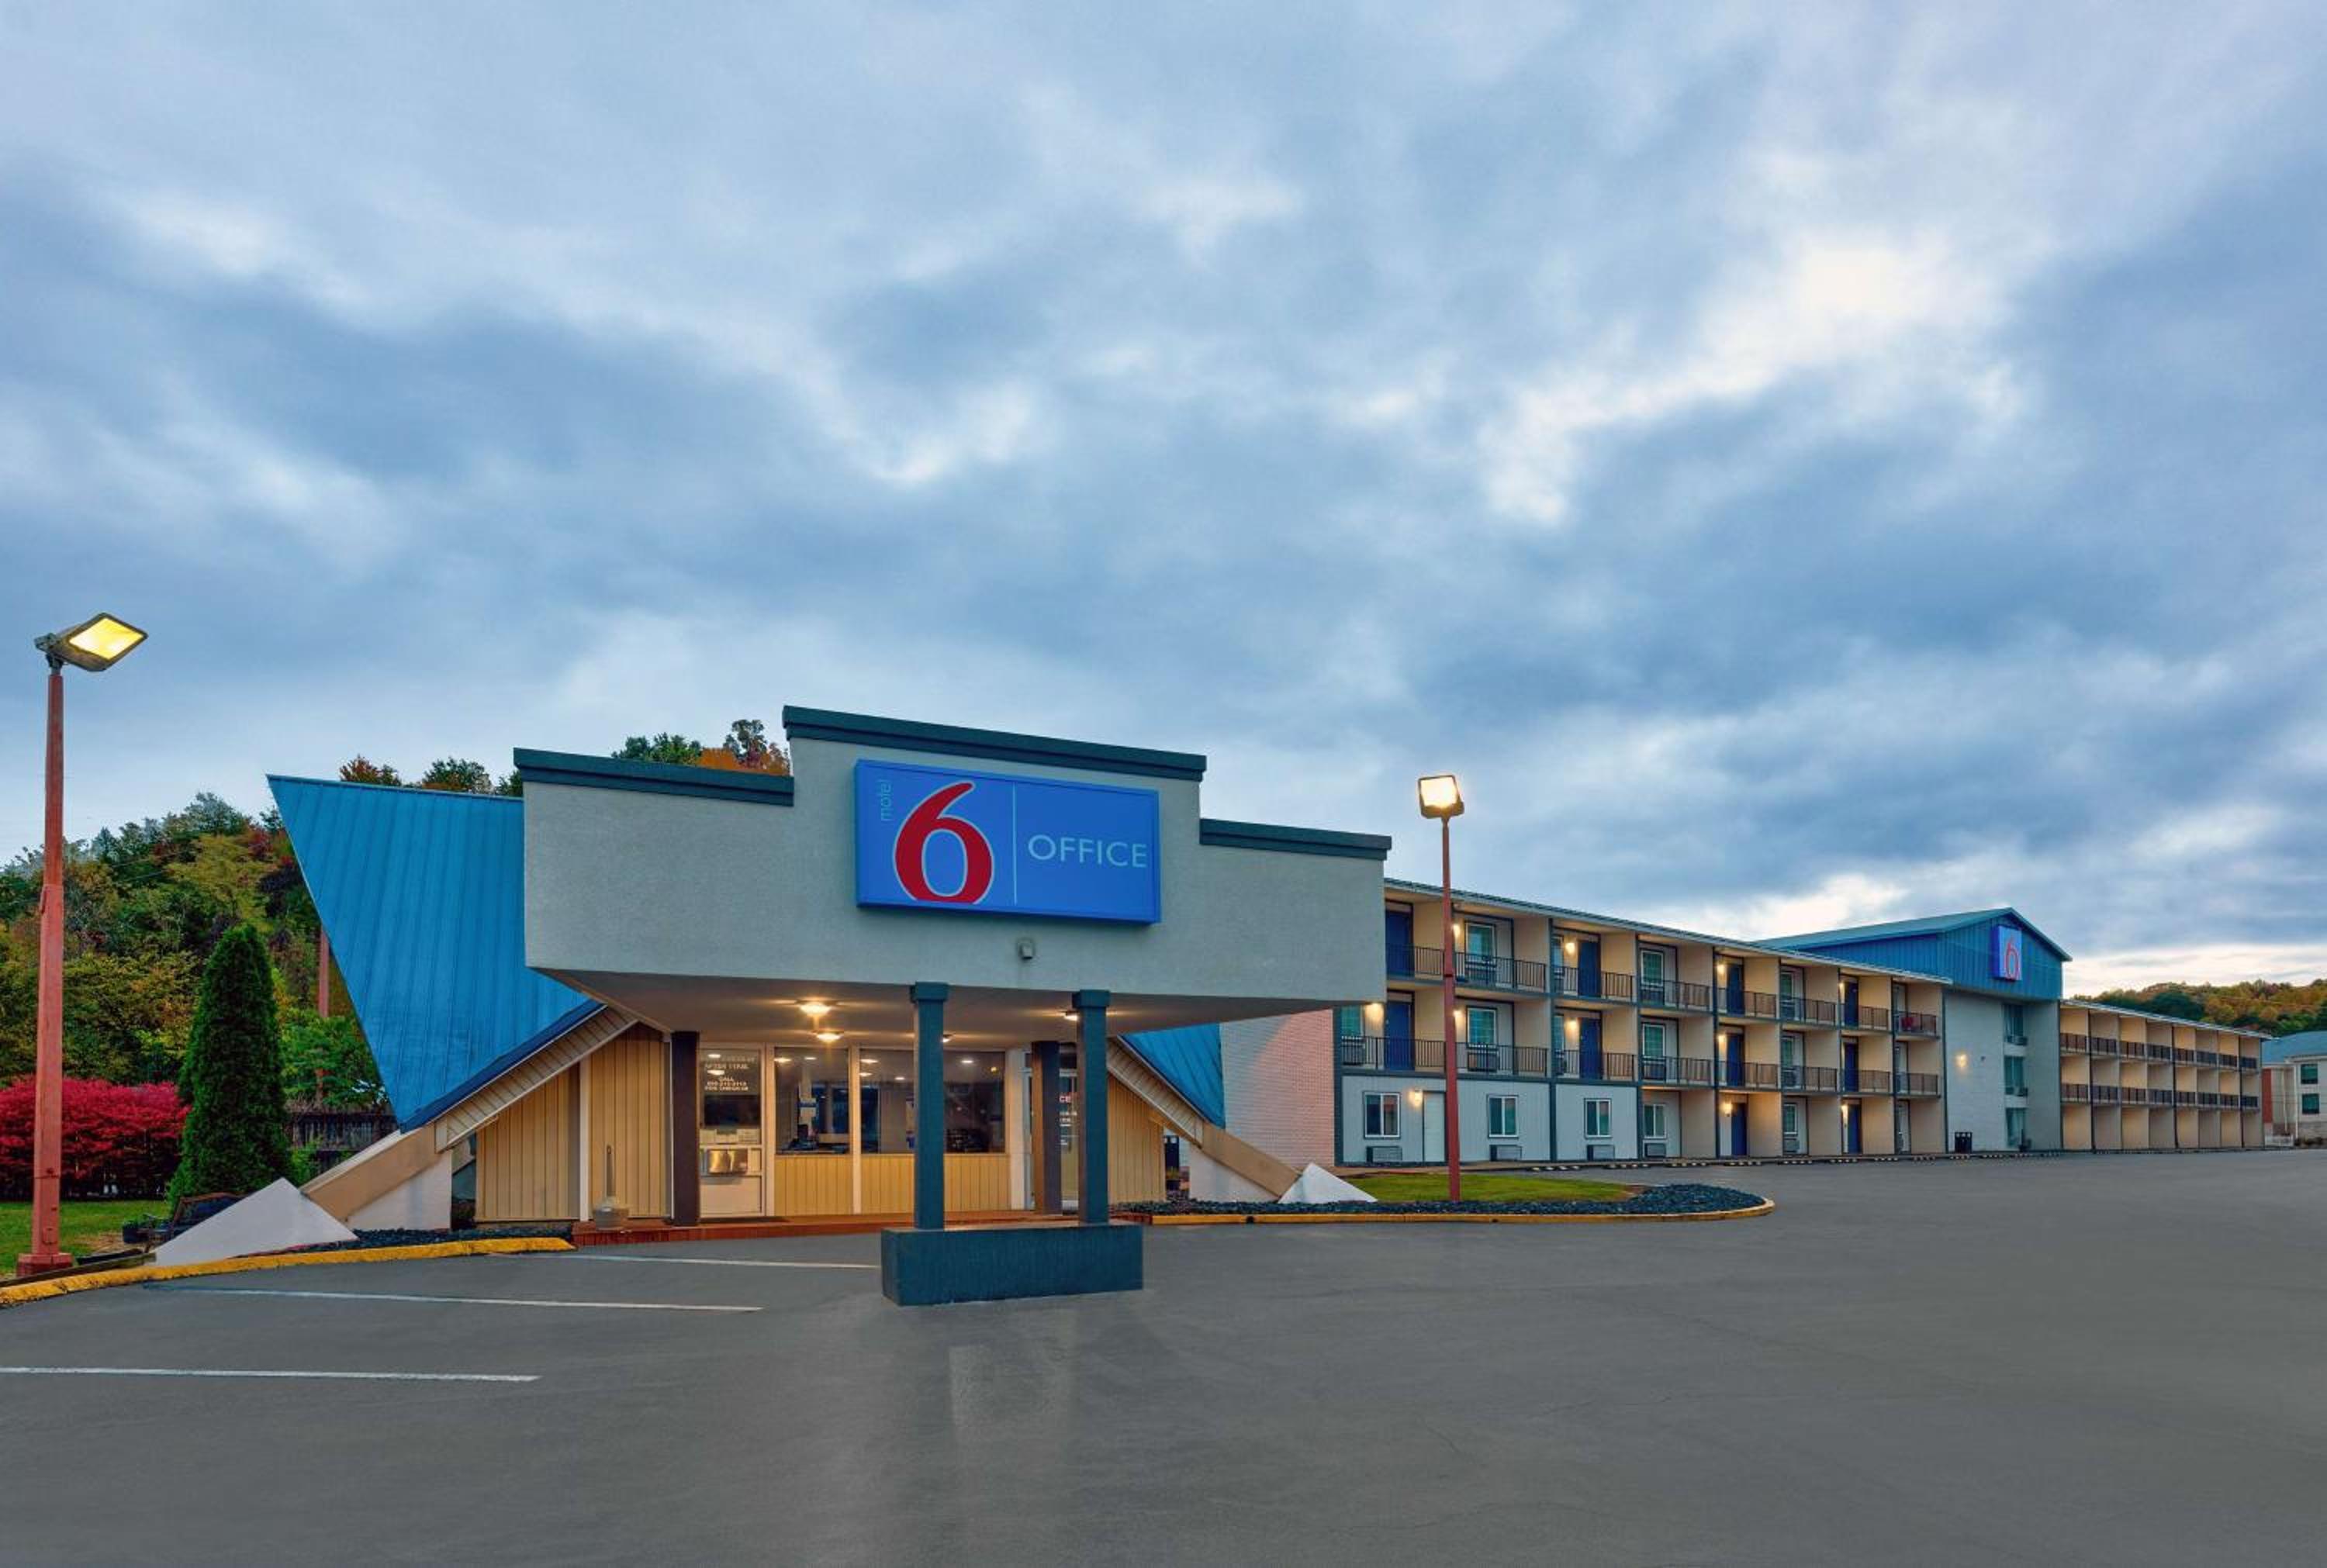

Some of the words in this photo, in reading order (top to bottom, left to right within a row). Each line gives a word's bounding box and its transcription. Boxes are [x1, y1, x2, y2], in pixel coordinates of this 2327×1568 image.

[876, 779, 893, 822] motel
[893, 781, 994, 905] 6
[1028, 834, 1147, 868] OFFICE
[2004, 935, 2020, 980] 6
